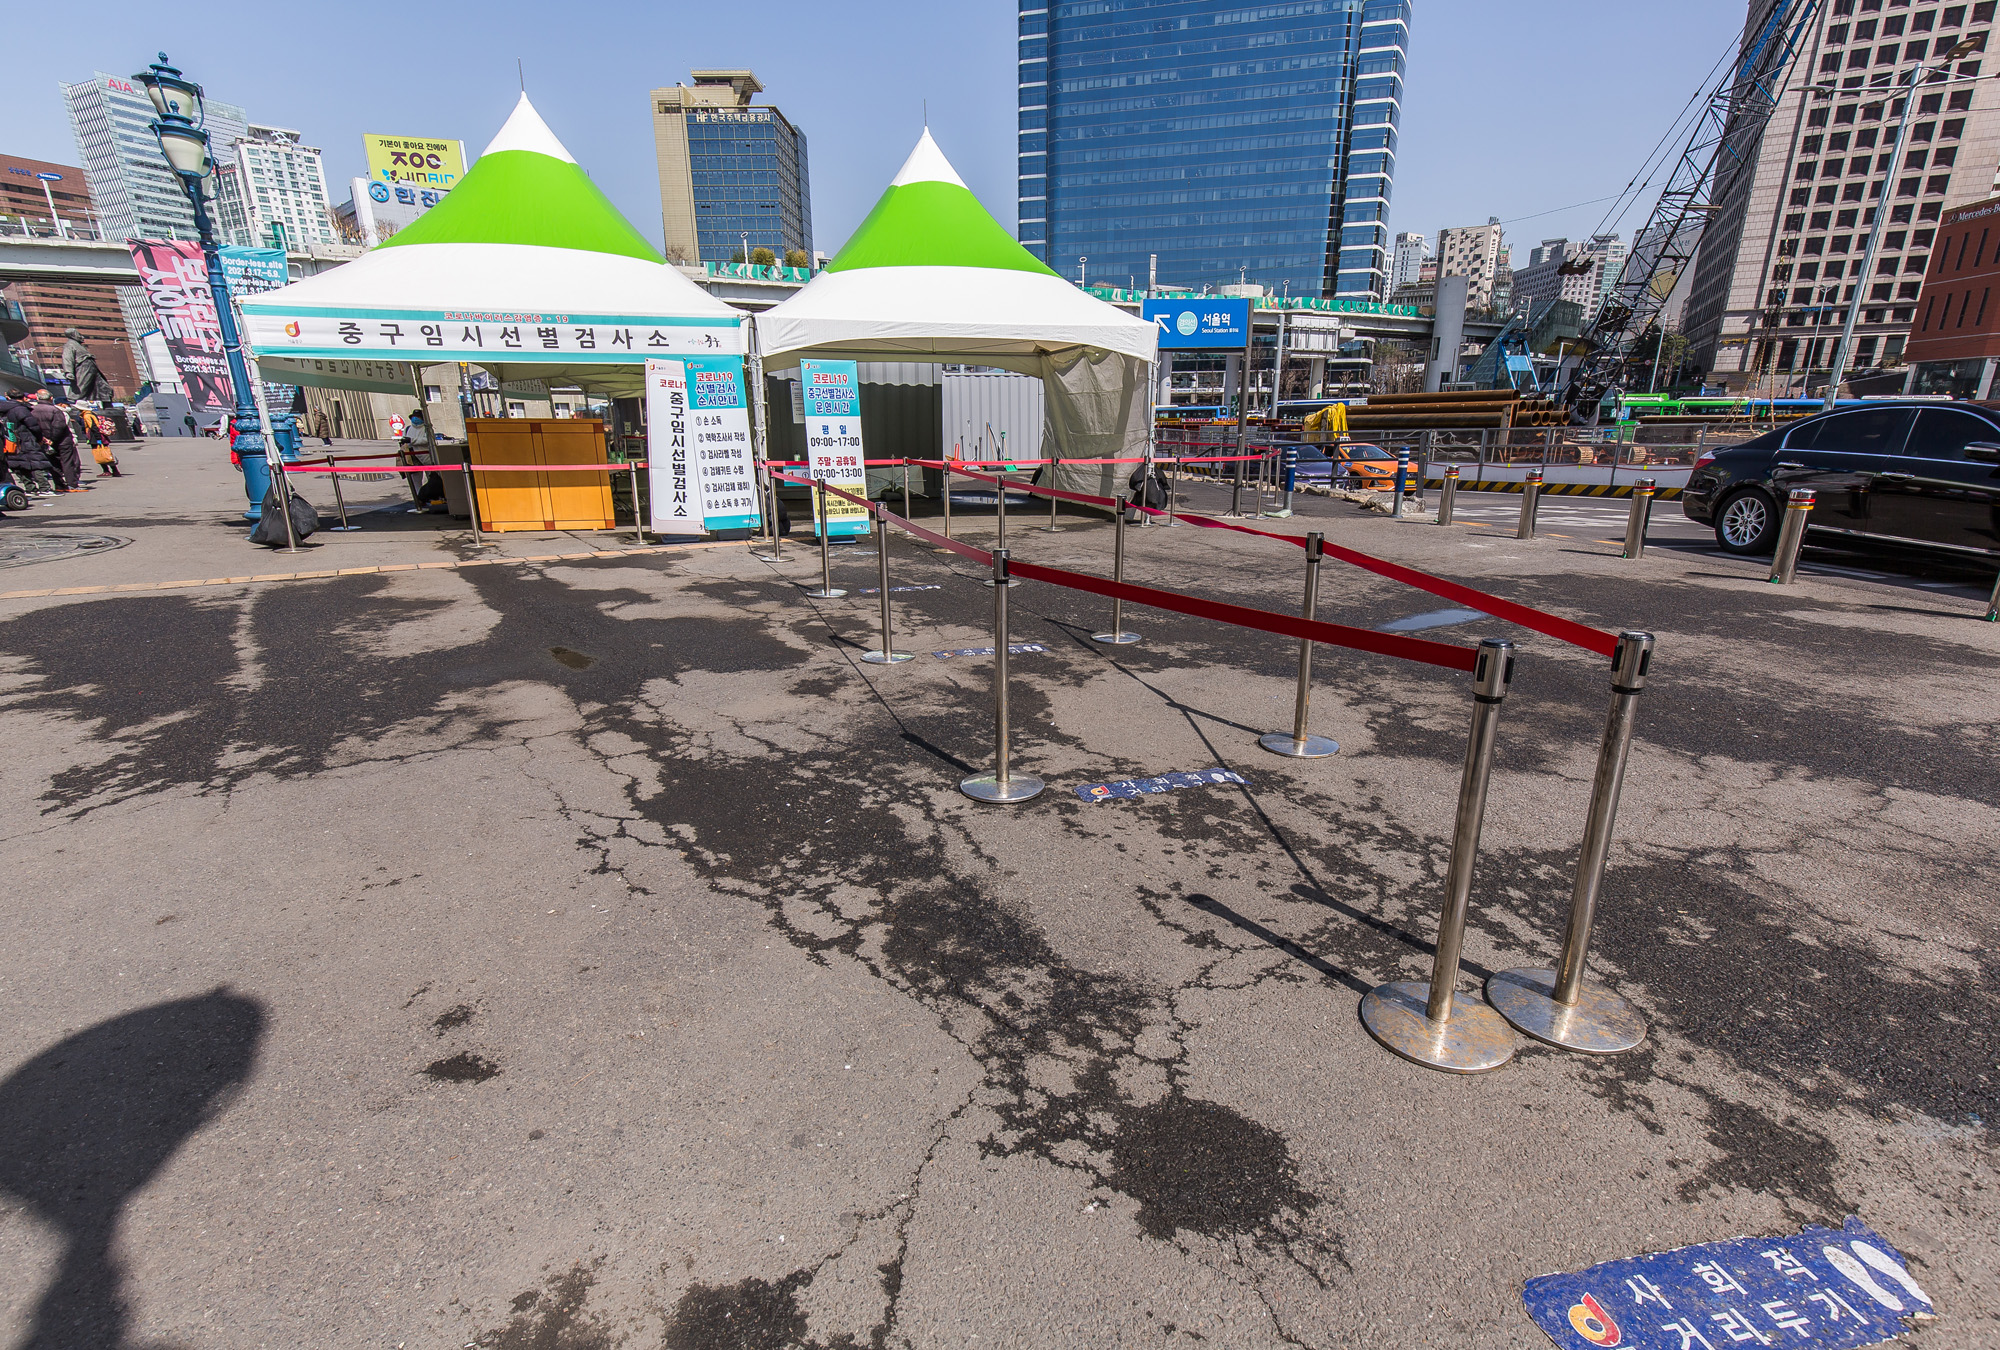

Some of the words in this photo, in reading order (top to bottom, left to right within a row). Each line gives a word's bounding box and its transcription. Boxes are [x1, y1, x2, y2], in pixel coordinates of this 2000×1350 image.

[108, 78, 134, 94] AIA
[696, 113, 708, 123] HF
[710, 113, 771, 123] 한국주택금융공사
[378, 139, 401, 149] 기본이
[426, 143, 448, 151] 진에어
[556, 315, 568, 323] 19
[1201, 312, 1231, 327] 서울역
[338, 321, 670, 350] 중구임시선별검사소
[695, 372, 733, 382] 코로나19
[813, 373, 848, 384] 코로나19
[659, 378, 687, 390] 코로나1
[695, 383, 736, 394] 선별검사
[808, 387, 855, 400] 중구선별검사소
[697, 395, 738, 407] 순서안내
[815, 401, 850, 414] 운영시간
[703, 416, 710, 426] 손
[810, 436, 860, 447] 09:00~17:00
[669, 391, 688, 517] 중구임시선별검사소
[813, 468, 863, 478] 09:00~13:00
[1626, 1248, 1820, 1310] 사회적
[1661, 1287, 1870, 1350] 거리두기
